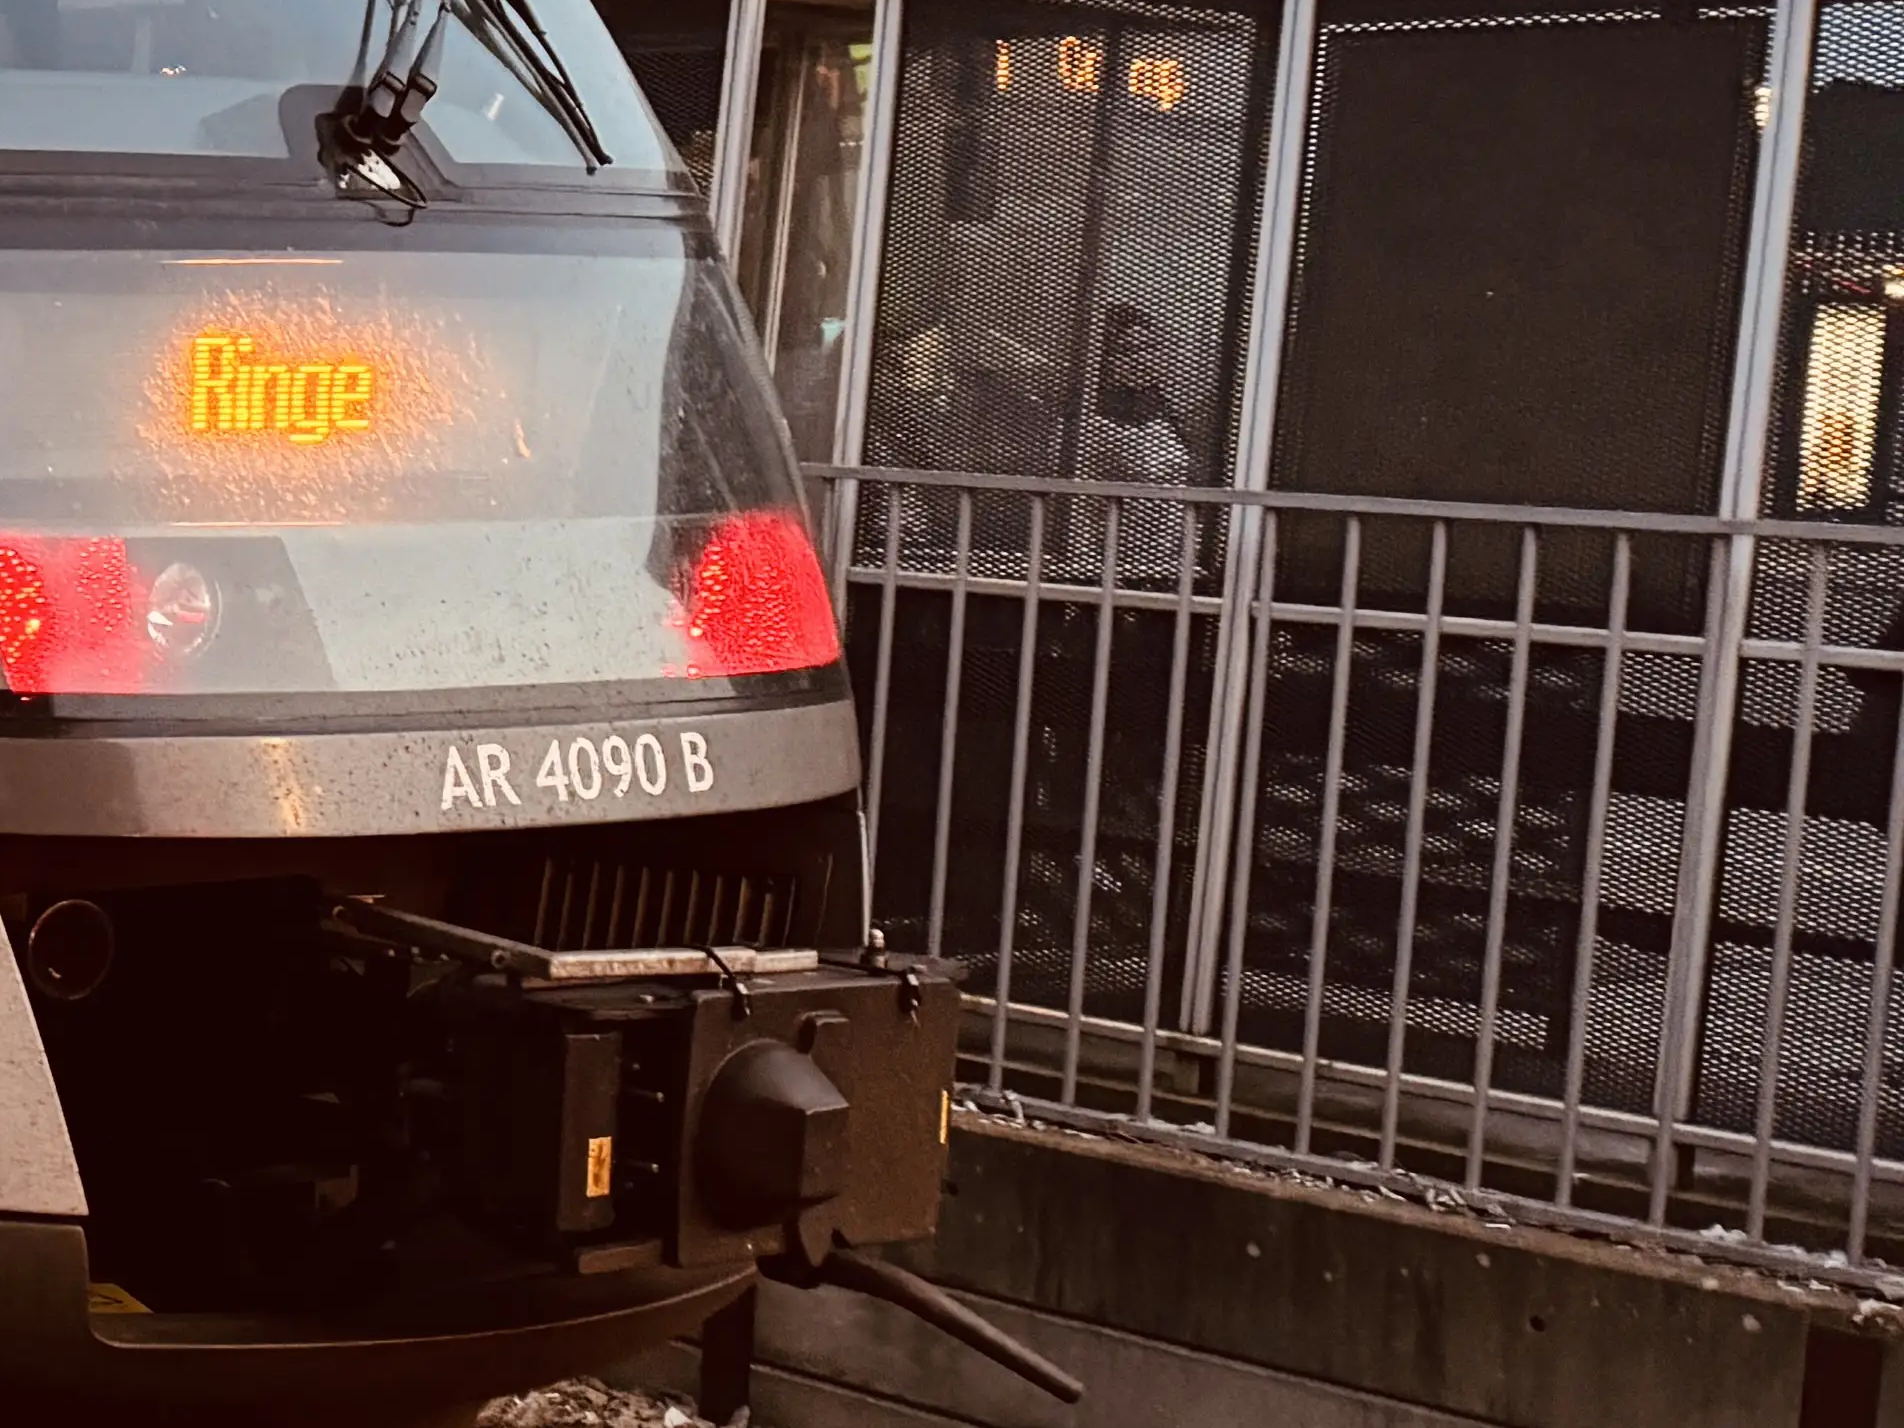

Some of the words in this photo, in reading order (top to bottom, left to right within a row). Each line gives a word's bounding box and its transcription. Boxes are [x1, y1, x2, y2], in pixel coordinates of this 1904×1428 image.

[192, 337, 374, 442] Ringe
[441, 743, 522, 810] AR
[536, 733, 667, 801] 4090
[680, 732, 714, 793] B
